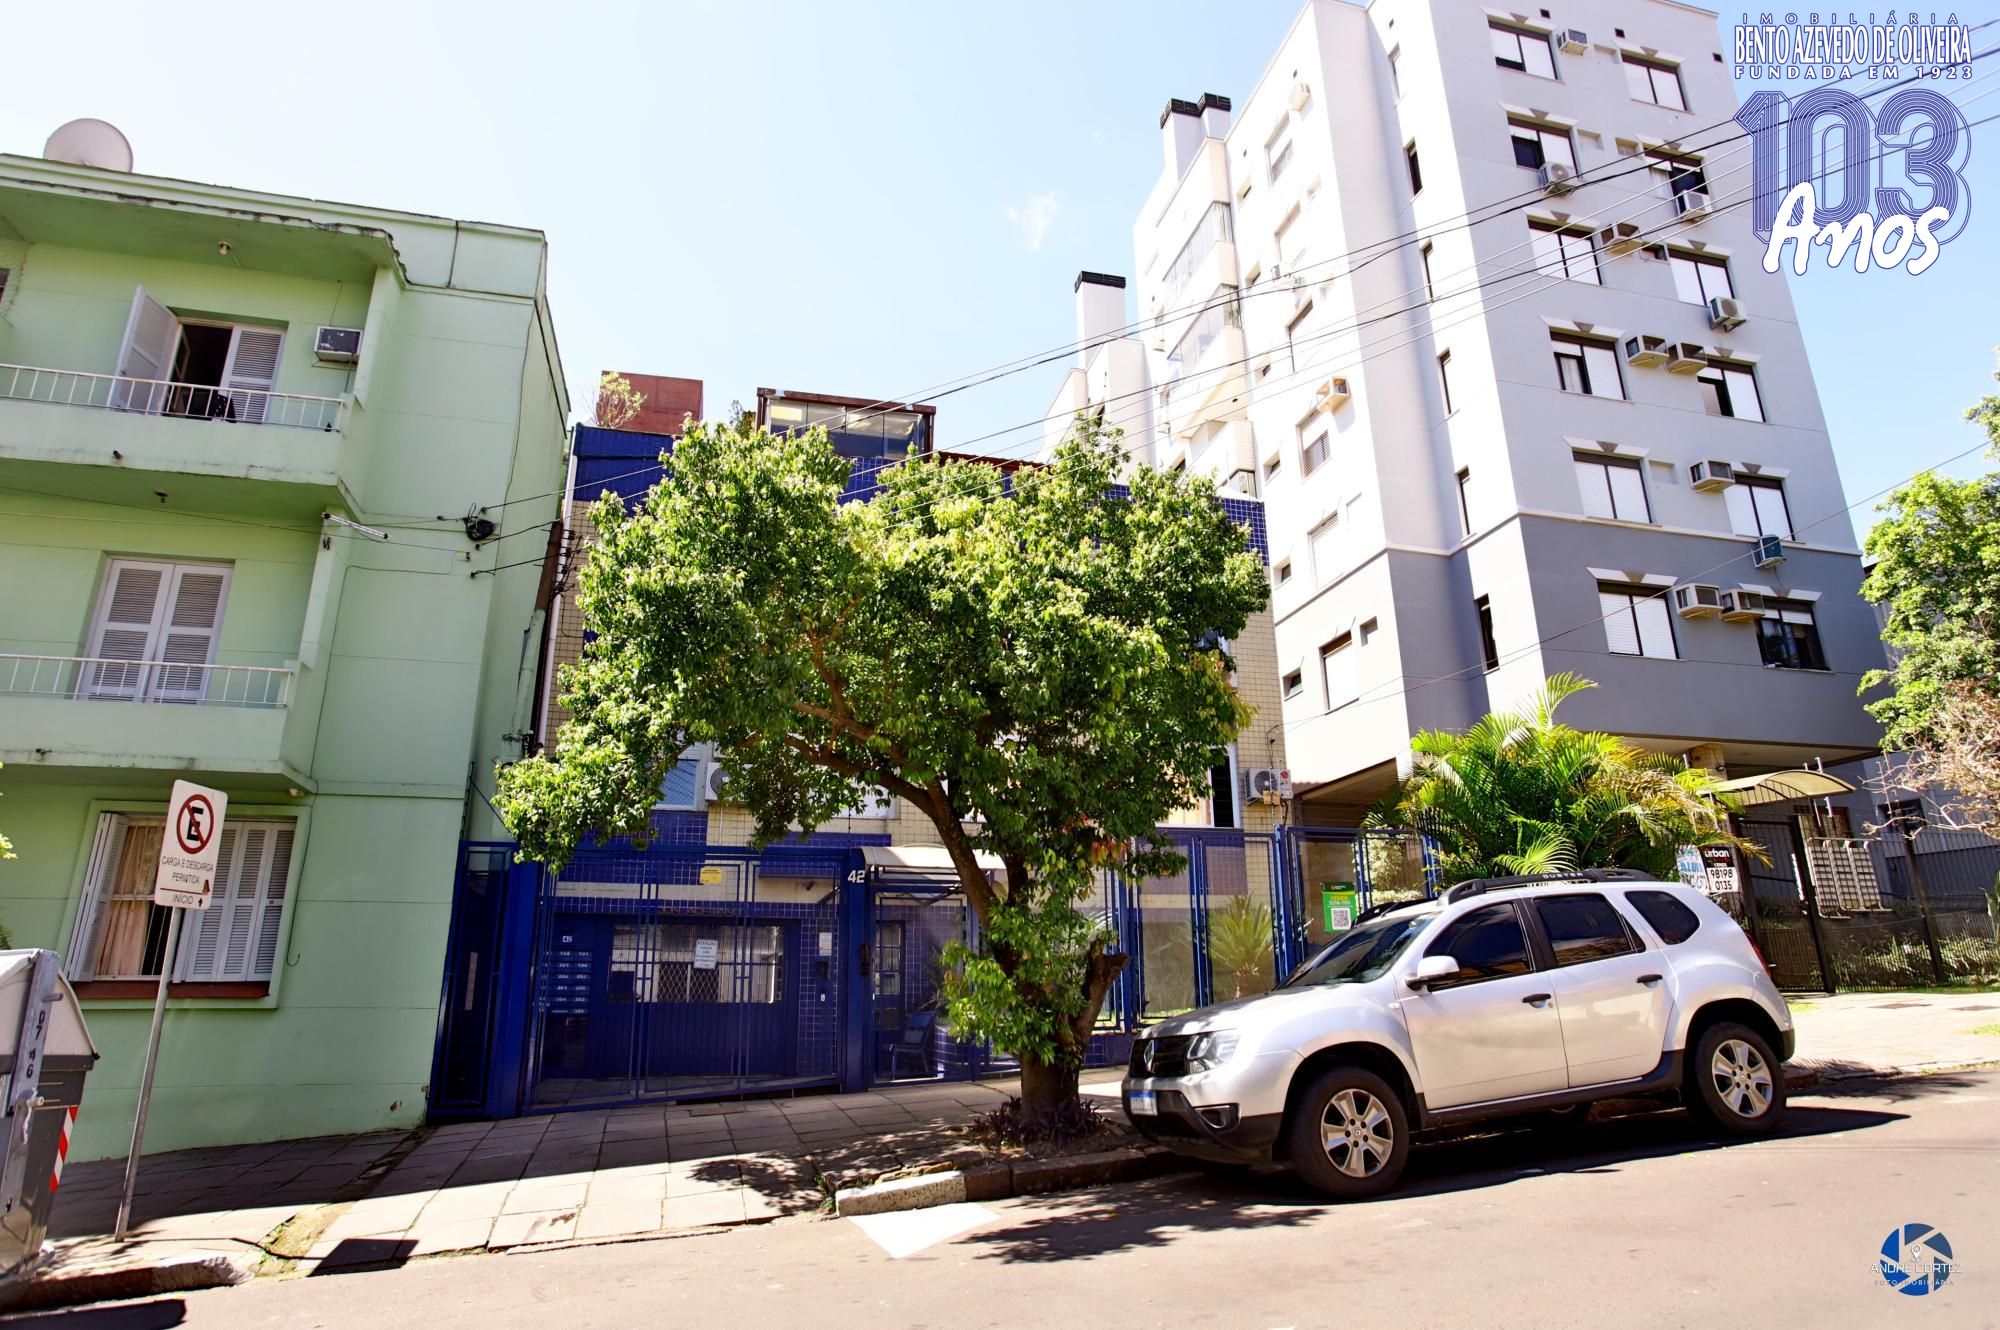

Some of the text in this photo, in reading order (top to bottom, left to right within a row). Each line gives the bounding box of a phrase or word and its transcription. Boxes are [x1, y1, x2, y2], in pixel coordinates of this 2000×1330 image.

[162, 855, 214, 872] CARGA E DESCARGA
[848, 870, 865, 883] 42
[1710, 869, 1733, 879] 98198
[1715, 880, 1732, 890] 0135
[172, 893, 194, 905] INÍCIO
